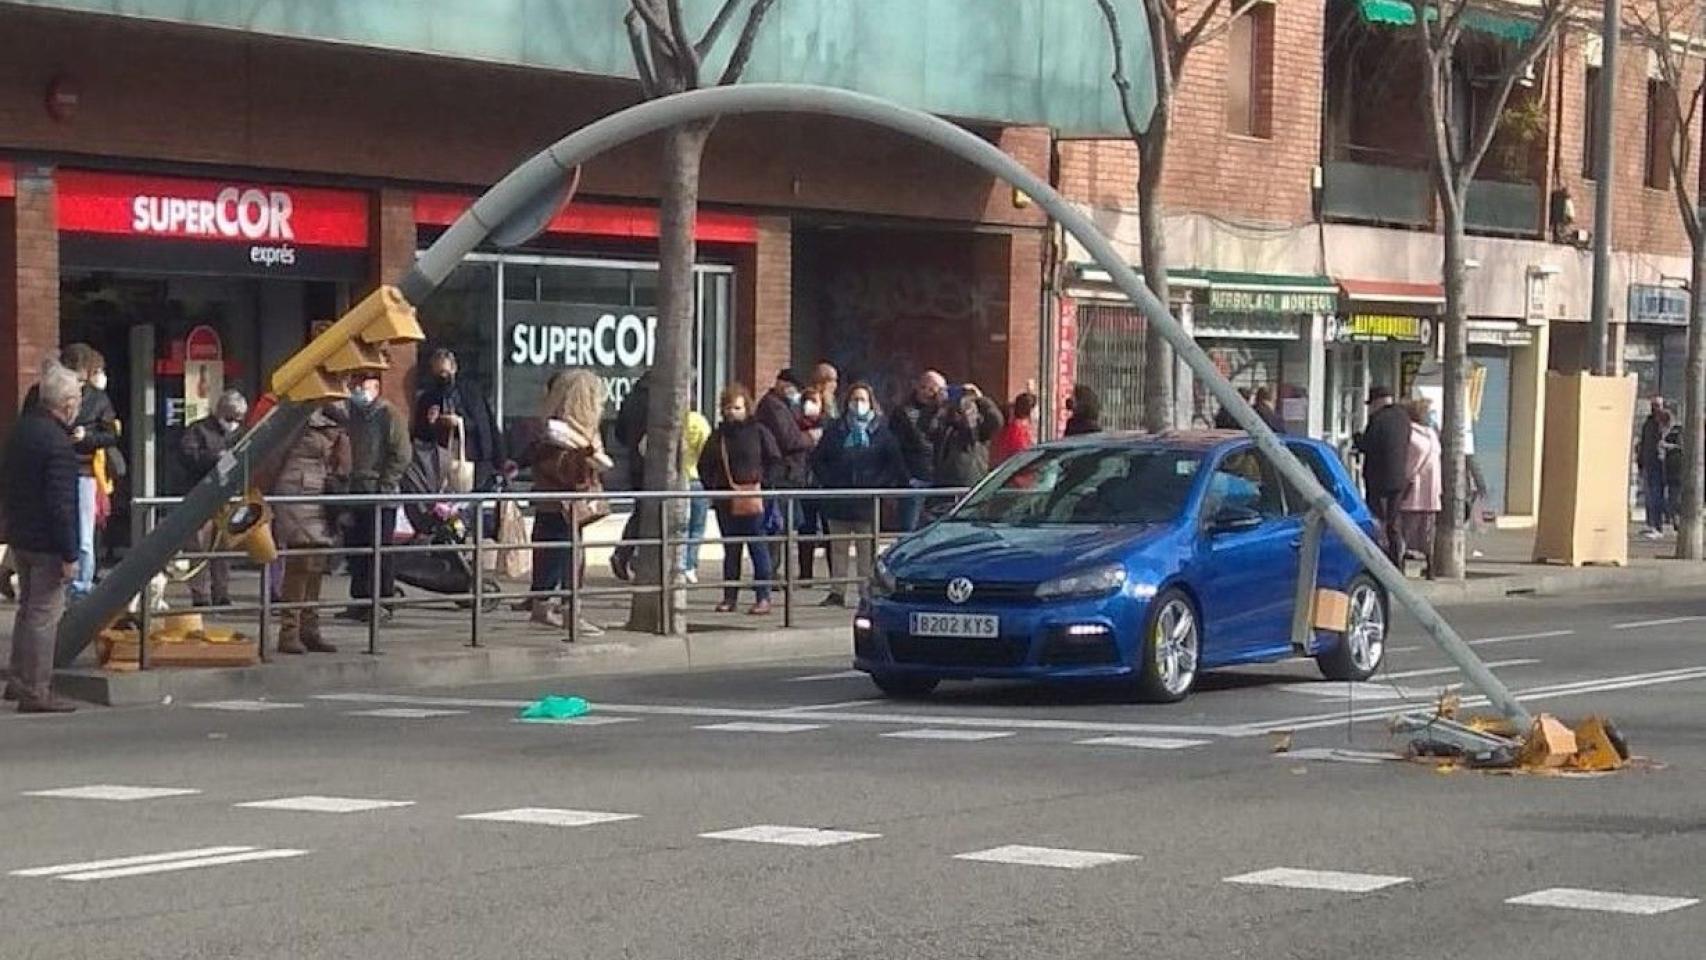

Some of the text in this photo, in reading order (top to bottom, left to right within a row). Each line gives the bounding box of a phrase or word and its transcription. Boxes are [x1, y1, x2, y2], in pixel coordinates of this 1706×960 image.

[132, 186, 294, 240] SUPERCOR
[250, 243, 296, 265] exprés
[963, 617, 995, 635] KYS
